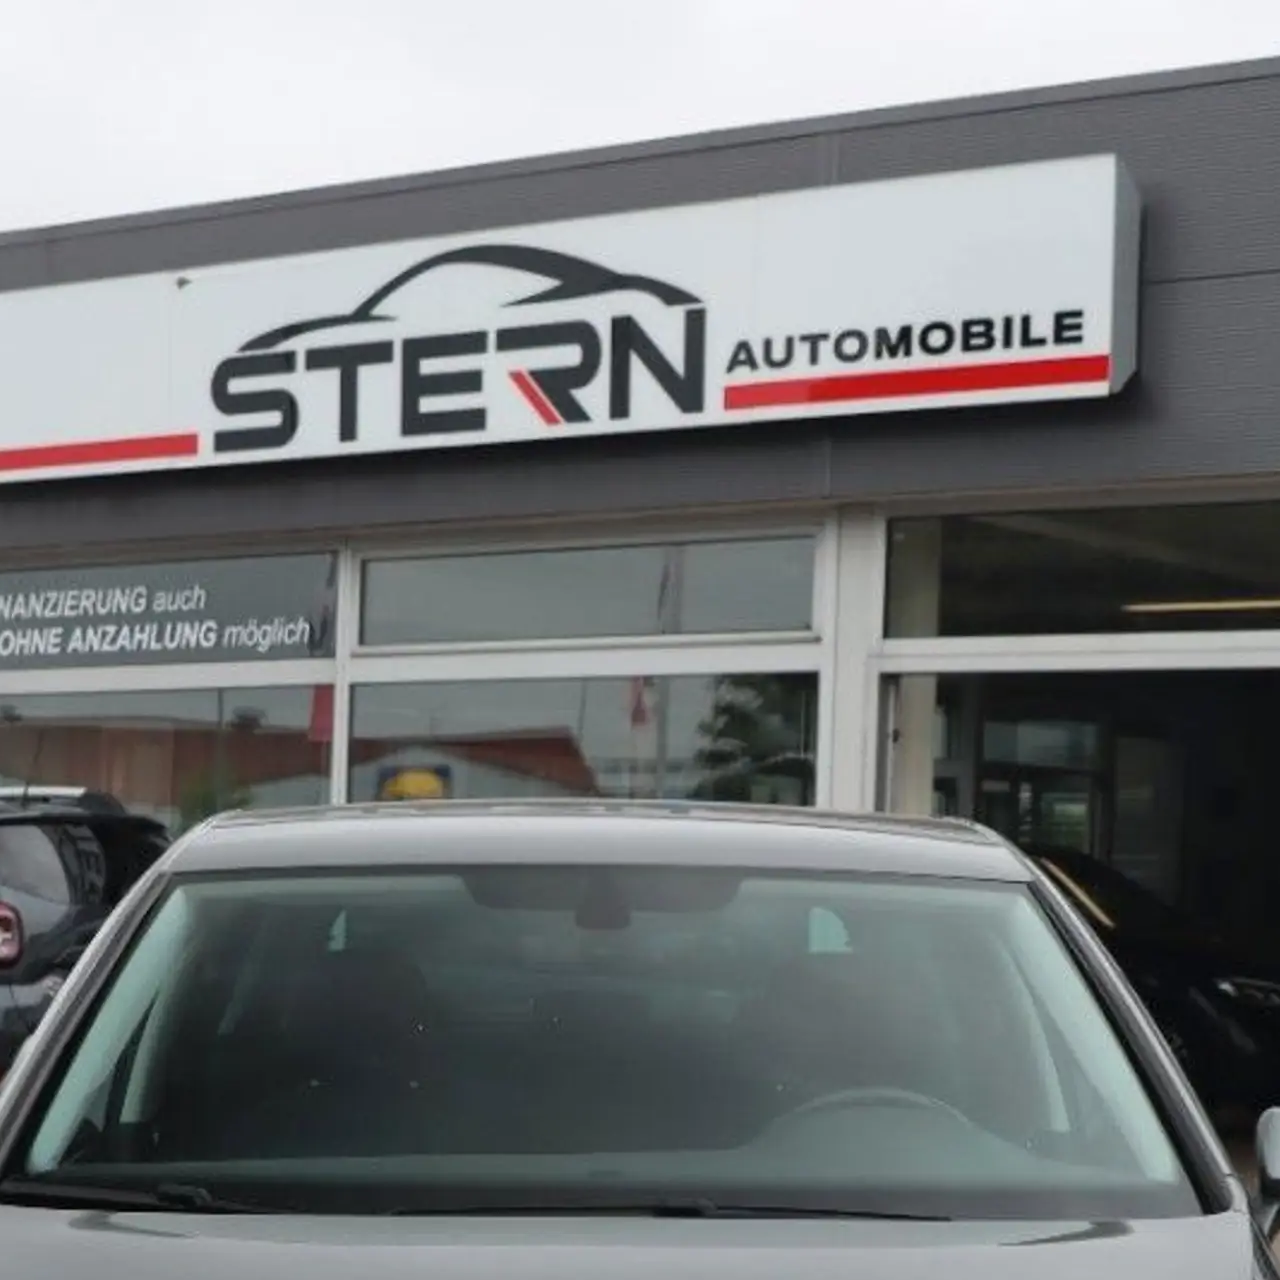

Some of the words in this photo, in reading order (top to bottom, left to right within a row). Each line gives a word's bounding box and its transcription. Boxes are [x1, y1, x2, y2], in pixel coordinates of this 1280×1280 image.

[211, 308, 706, 453] STERN
[725, 310, 1084, 373] AUTOMOBILE
[153, 585, 206, 611] auch
[67, 620, 217, 652] ANZAHLUNG
[222, 619, 311, 653] möglich
